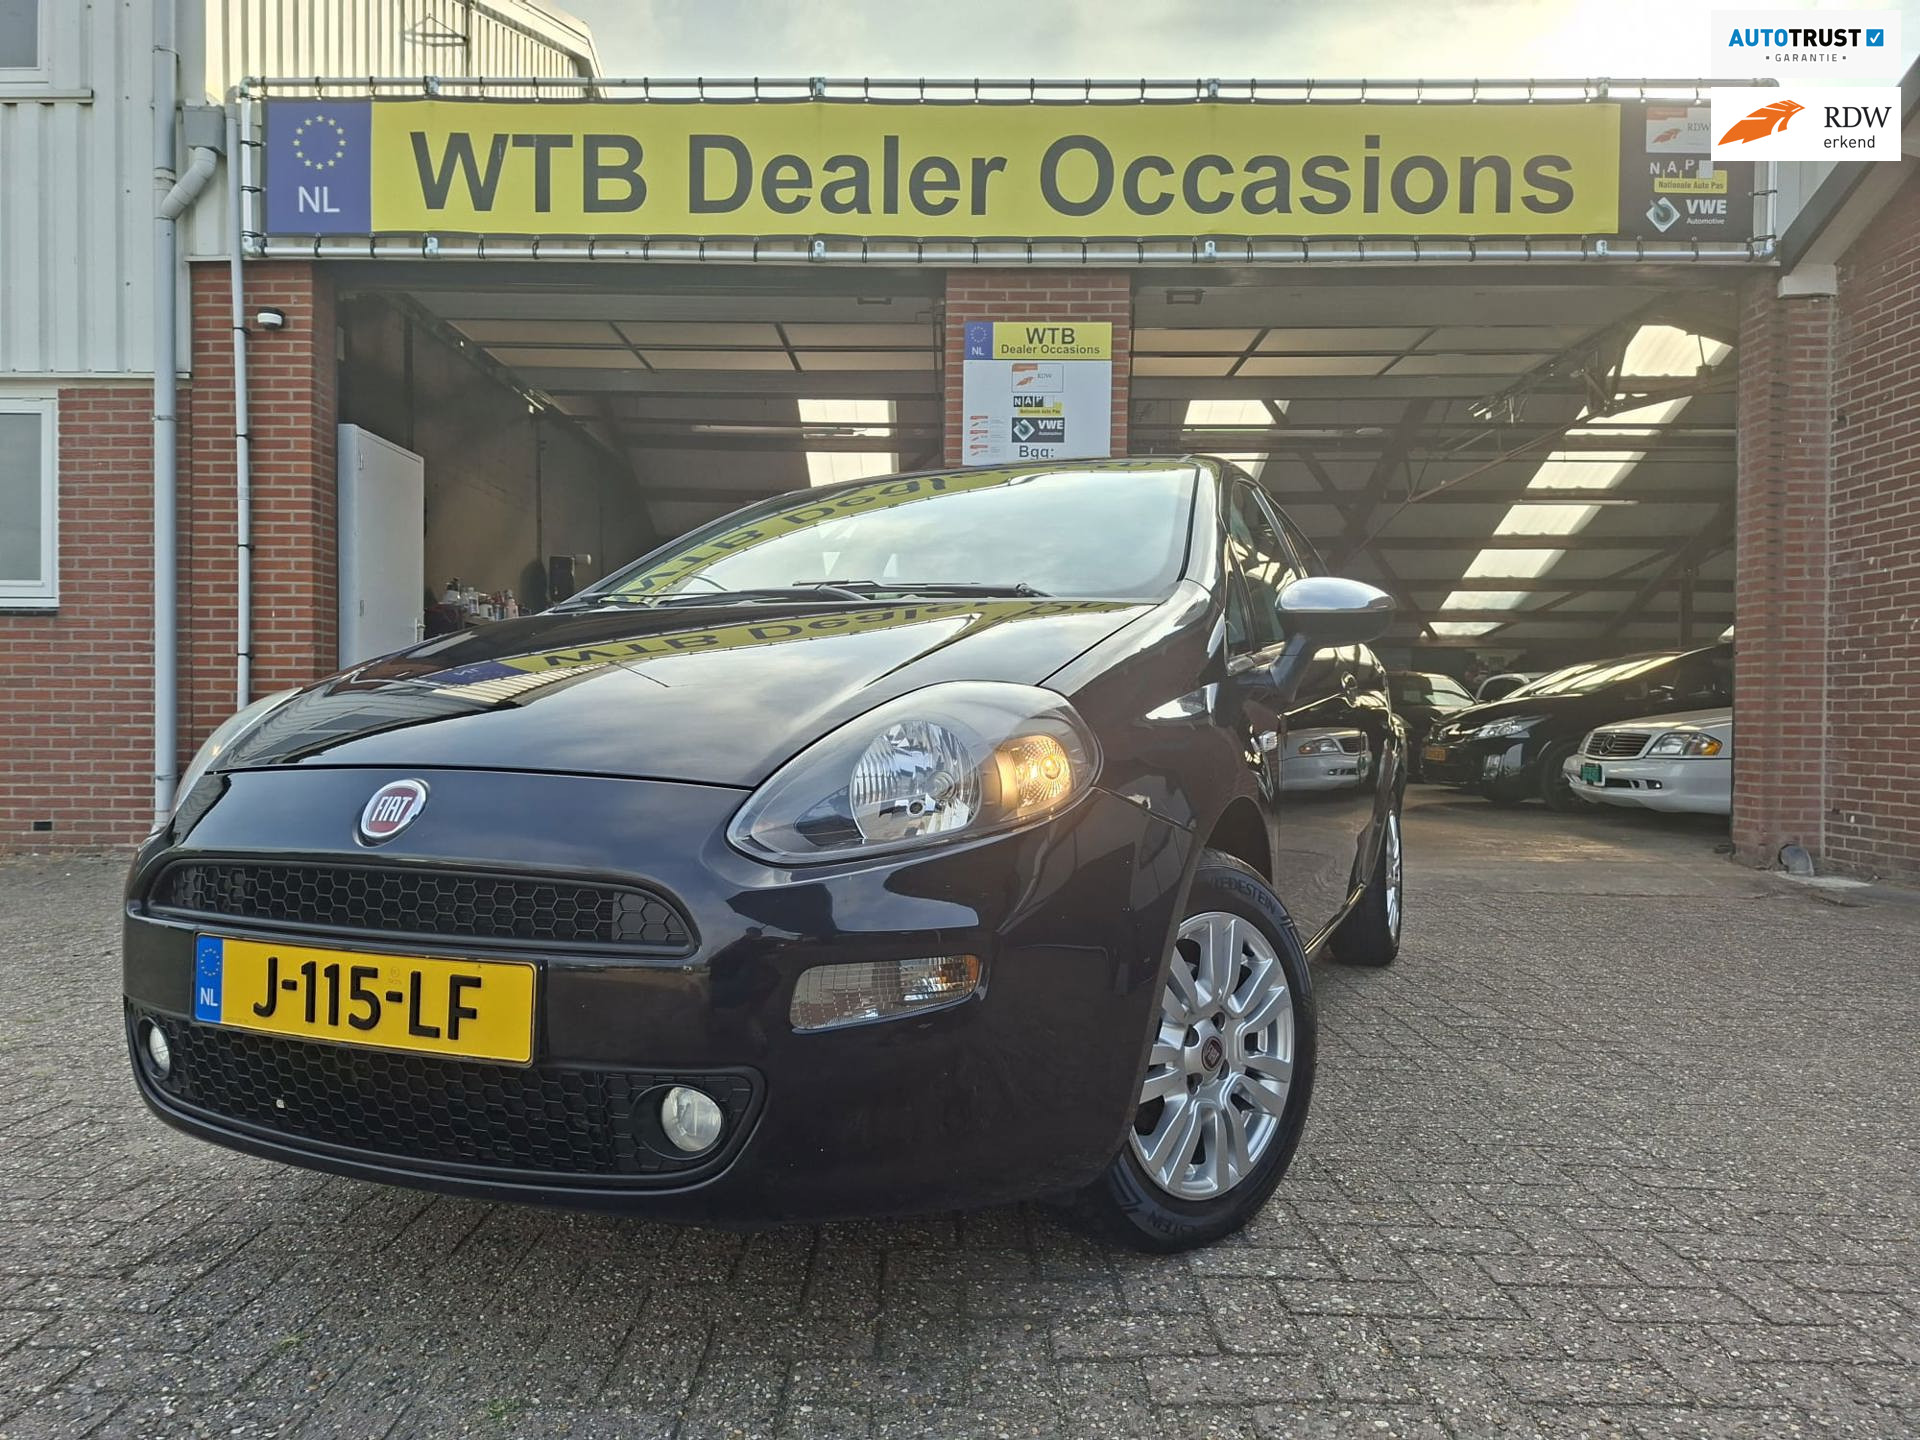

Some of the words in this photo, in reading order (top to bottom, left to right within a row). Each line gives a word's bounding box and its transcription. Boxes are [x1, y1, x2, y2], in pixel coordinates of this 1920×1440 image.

[409, 131, 647, 213] WTB
[689, 134, 1008, 217] Dealer
[1040, 134, 1574, 217] Occasions
[298, 186, 340, 213] NL
[1686, 199, 1727, 214] VWE
[1686, 217, 1725, 225] Automotive
[1026, 327, 1075, 345] WTB
[971, 347, 984, 356] NL
[1001, 344, 1036, 354] Dealer
[1040, 344, 1101, 354] Occasions
[1038, 420, 1063, 430] VWE
[371, 796, 413, 822] FIAT
[200, 987, 218, 1007] NL
[253, 956, 482, 1040] J-115-LF
